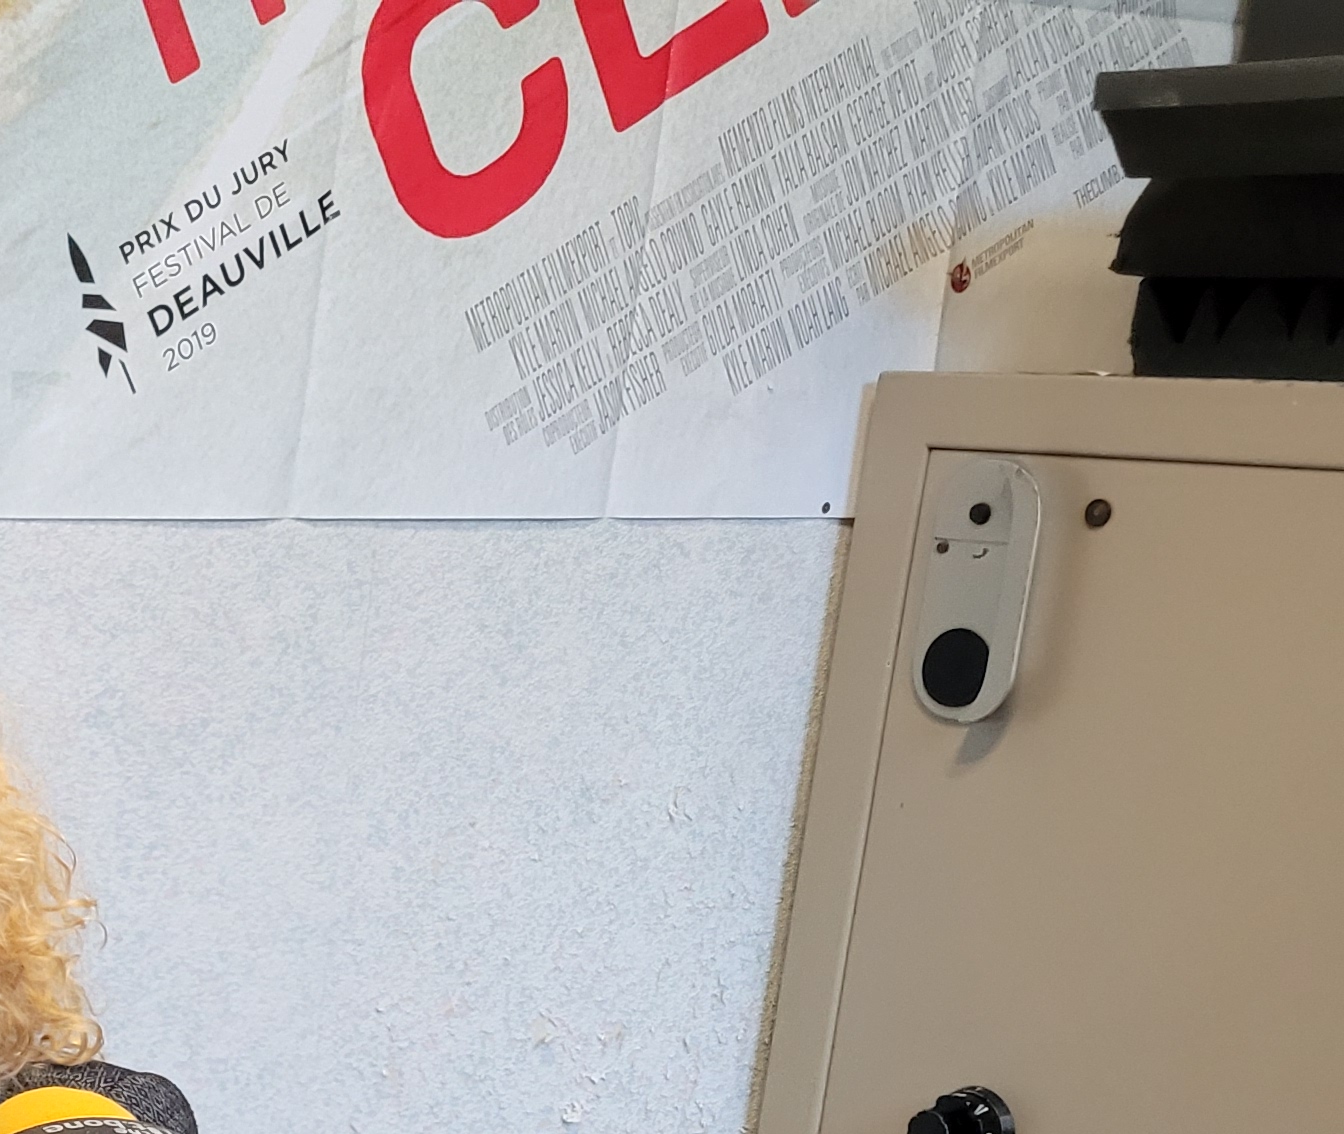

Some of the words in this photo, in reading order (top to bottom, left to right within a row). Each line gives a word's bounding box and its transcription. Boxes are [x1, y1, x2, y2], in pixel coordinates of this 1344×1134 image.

[717, 107, 774, 177] MEMENTO
[767, 85, 806, 144] FILMS
[798, 35, 880, 122] INTERNATIONAL
[838, 154, 867, 205] JON
[859, 125, 908, 191] NATCHEZ
[118, 211, 181, 265] PRIX
[183, 184, 222, 224] DU
[231, 138, 289, 196] JURY
[131, 212, 252, 299] FESTIVAL
[254, 181, 291, 220] DE
[508, 325, 542, 380] KYLE
[533, 297, 583, 364] MARVIN
[577, 265, 630, 333] MICHAEL
[659, 211, 705, 275] COVINO
[699, 187, 739, 247] GAYLE
[730, 162, 776, 225] RANKIN
[770, 139, 809, 197] TALIA
[801, 110, 850, 176] BALSAM
[845, 82, 891, 146] GEORGE
[728, 224, 767, 282] LINDA
[759, 201, 800, 260] COHEN
[822, 205, 872, 271] MICHAEL
[865, 182, 906, 241] BLOOM
[902, 161, 937, 215] RYAN
[863, 231, 913, 296] MICHAEL
[985, 159, 1018, 212] KYLE
[1009, 132, 1057, 195] MARVIN
[969, 216, 1035, 270] METROPOLITAN
[972, 235, 1025, 280] FILMEXPORT
[146, 188, 342, 338] DEAUVILLE
[464, 261, 550, 353] METROPOLITAN
[541, 221, 610, 300] FILMEXPORT
[610, 195, 647, 253] TOPIC
[700, 299, 739, 356] GILDA
[730, 268, 784, 335] MORATTI
[161, 321, 217, 372] 2019
[530, 355, 579, 421] JESSICA
[570, 336, 607, 394] KELLY
[605, 300, 657, 369] REBECCA
[647, 280, 688, 338] DEALY
[590, 376, 629, 434] JASON
[619, 348, 667, 413] FISHER
[721, 343, 753, 396] KYLE
[744, 315, 792, 379] MARVIN
[787, 294, 823, 350] NOAH
[815, 275, 850, 330] LANG
